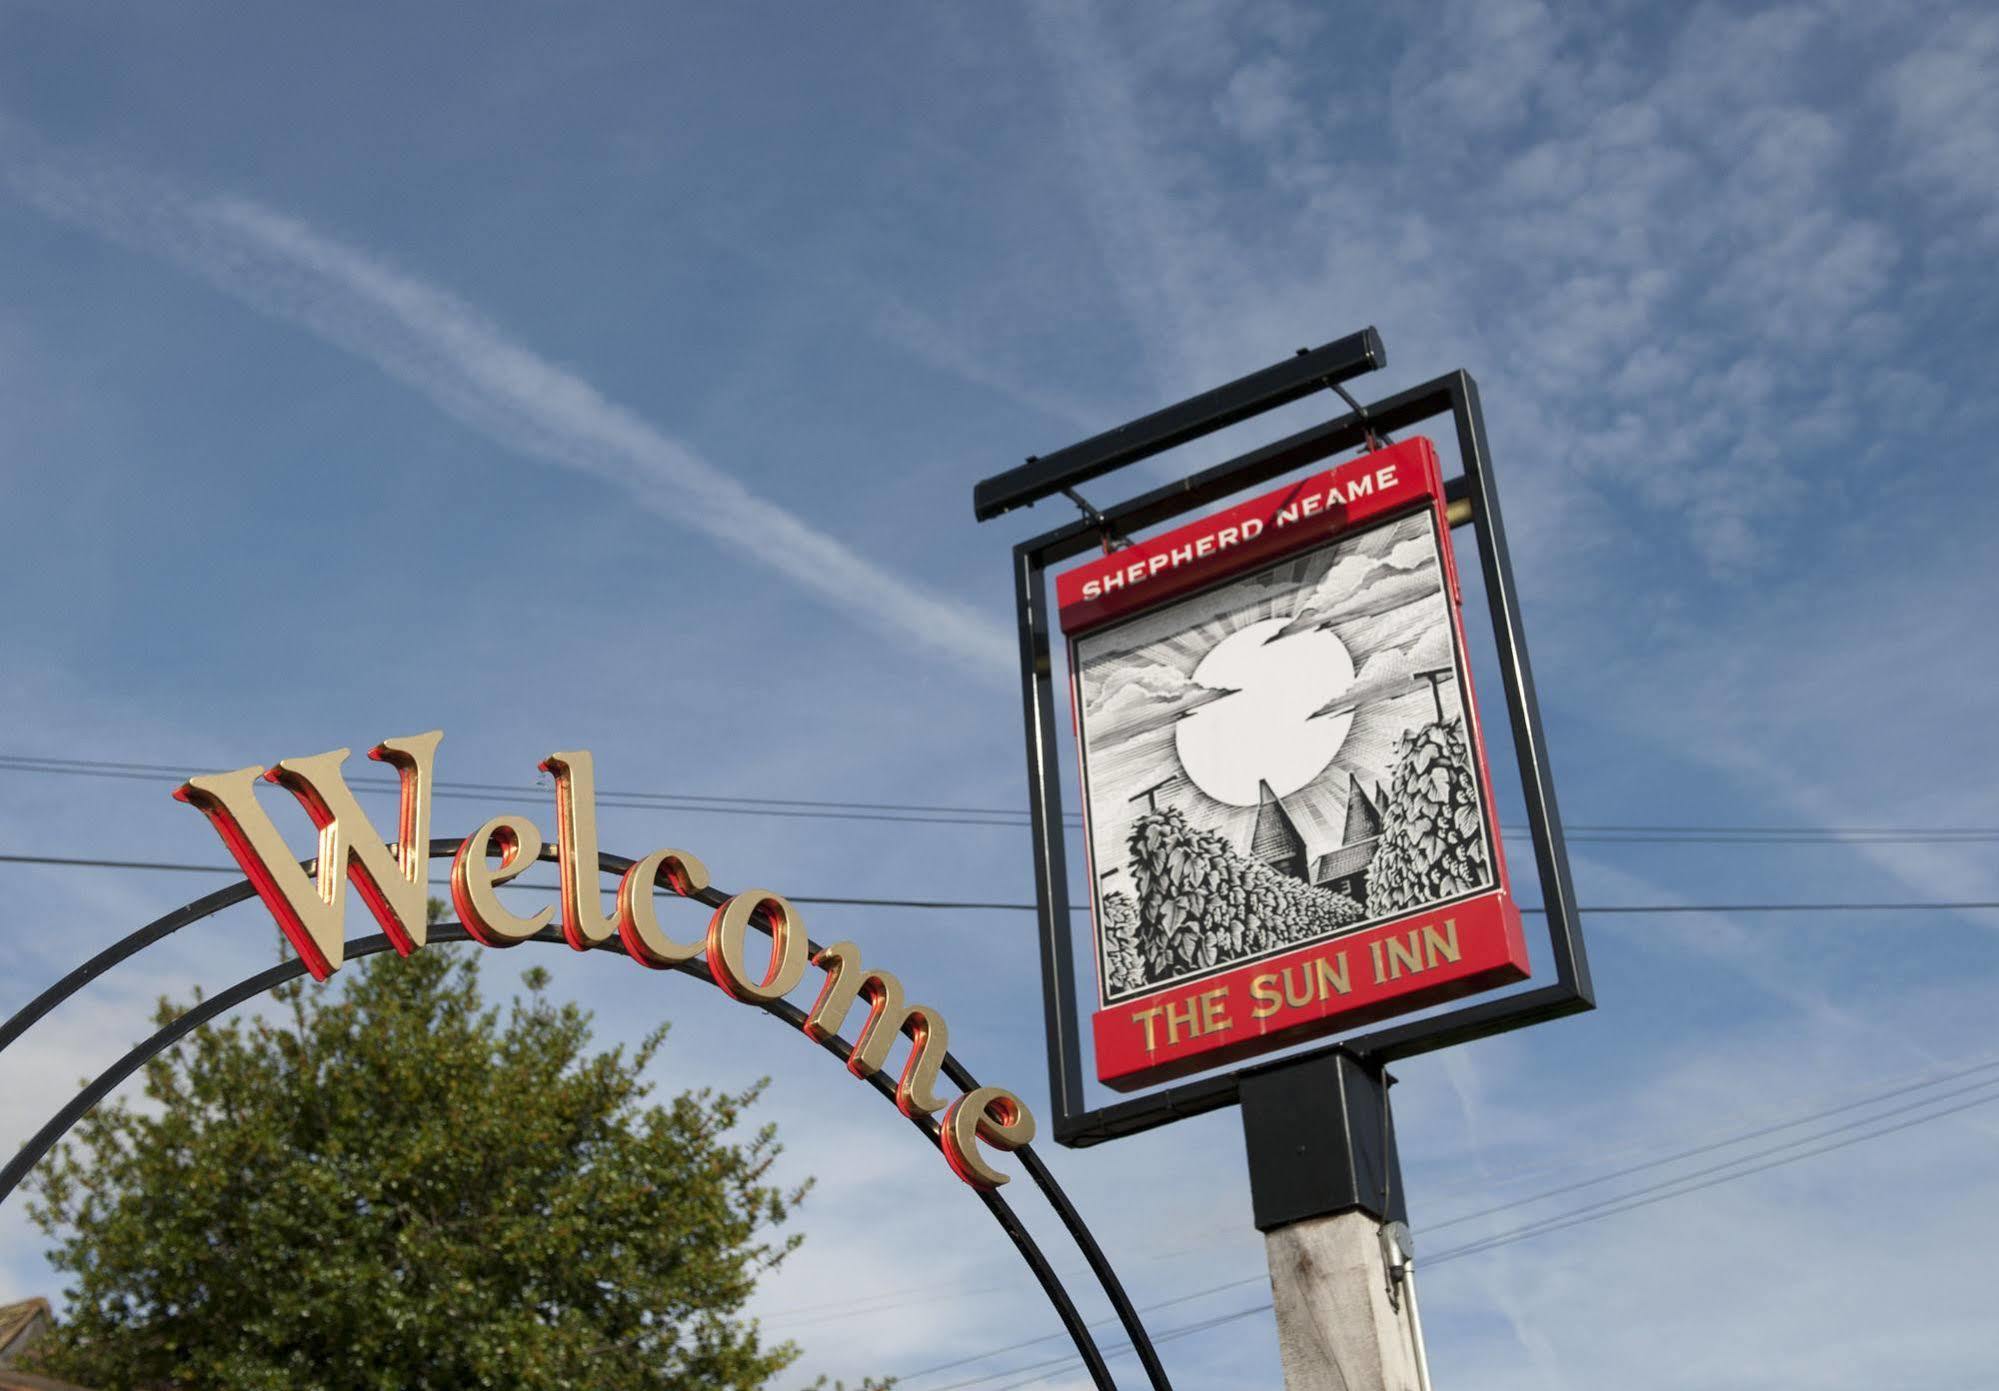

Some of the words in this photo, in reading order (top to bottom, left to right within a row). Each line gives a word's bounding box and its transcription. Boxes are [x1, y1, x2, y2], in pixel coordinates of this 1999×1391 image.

[1081, 518, 1263, 602] SHEPHERD
[1275, 464, 1399, 527] NEAME
[171, 730, 1036, 1191] Welcome
[1132, 987, 1233, 1051] THE
[1249, 950, 1351, 1020] SUN
[1369, 918, 1462, 985] INN
